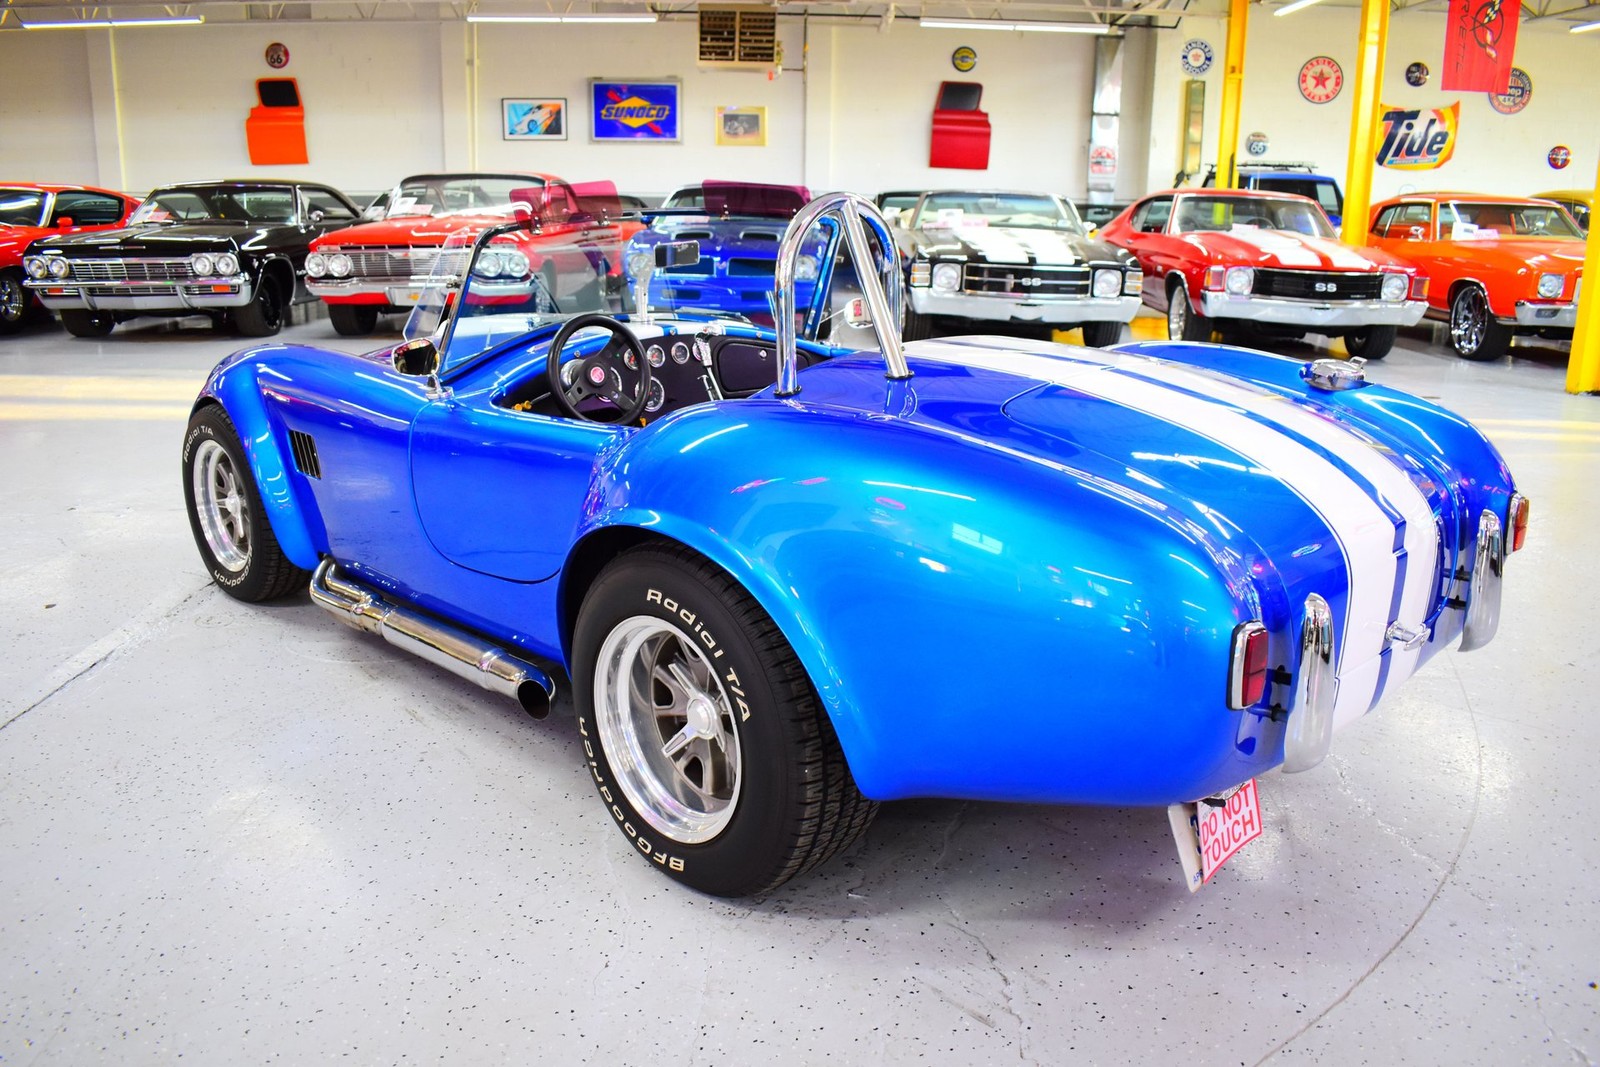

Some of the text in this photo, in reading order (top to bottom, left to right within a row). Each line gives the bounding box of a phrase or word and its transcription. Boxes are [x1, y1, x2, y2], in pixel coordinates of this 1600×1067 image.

[270, 54, 283, 64] 66
[603, 106, 667, 119] SUNOCO
[1250, 141, 1265, 154] 66
[1376, 109, 1449, 167] Tide
[1314, 282, 1338, 293] SS
[183, 427, 200, 463] Radial
[646, 588, 751, 722] Radial T/A
[579, 716, 685, 872] BFGoodrich
[1201, 811, 1218, 847] DO
[1221, 783, 1250, 825] NOT
[1204, 809, 1255, 870] TOUCH
